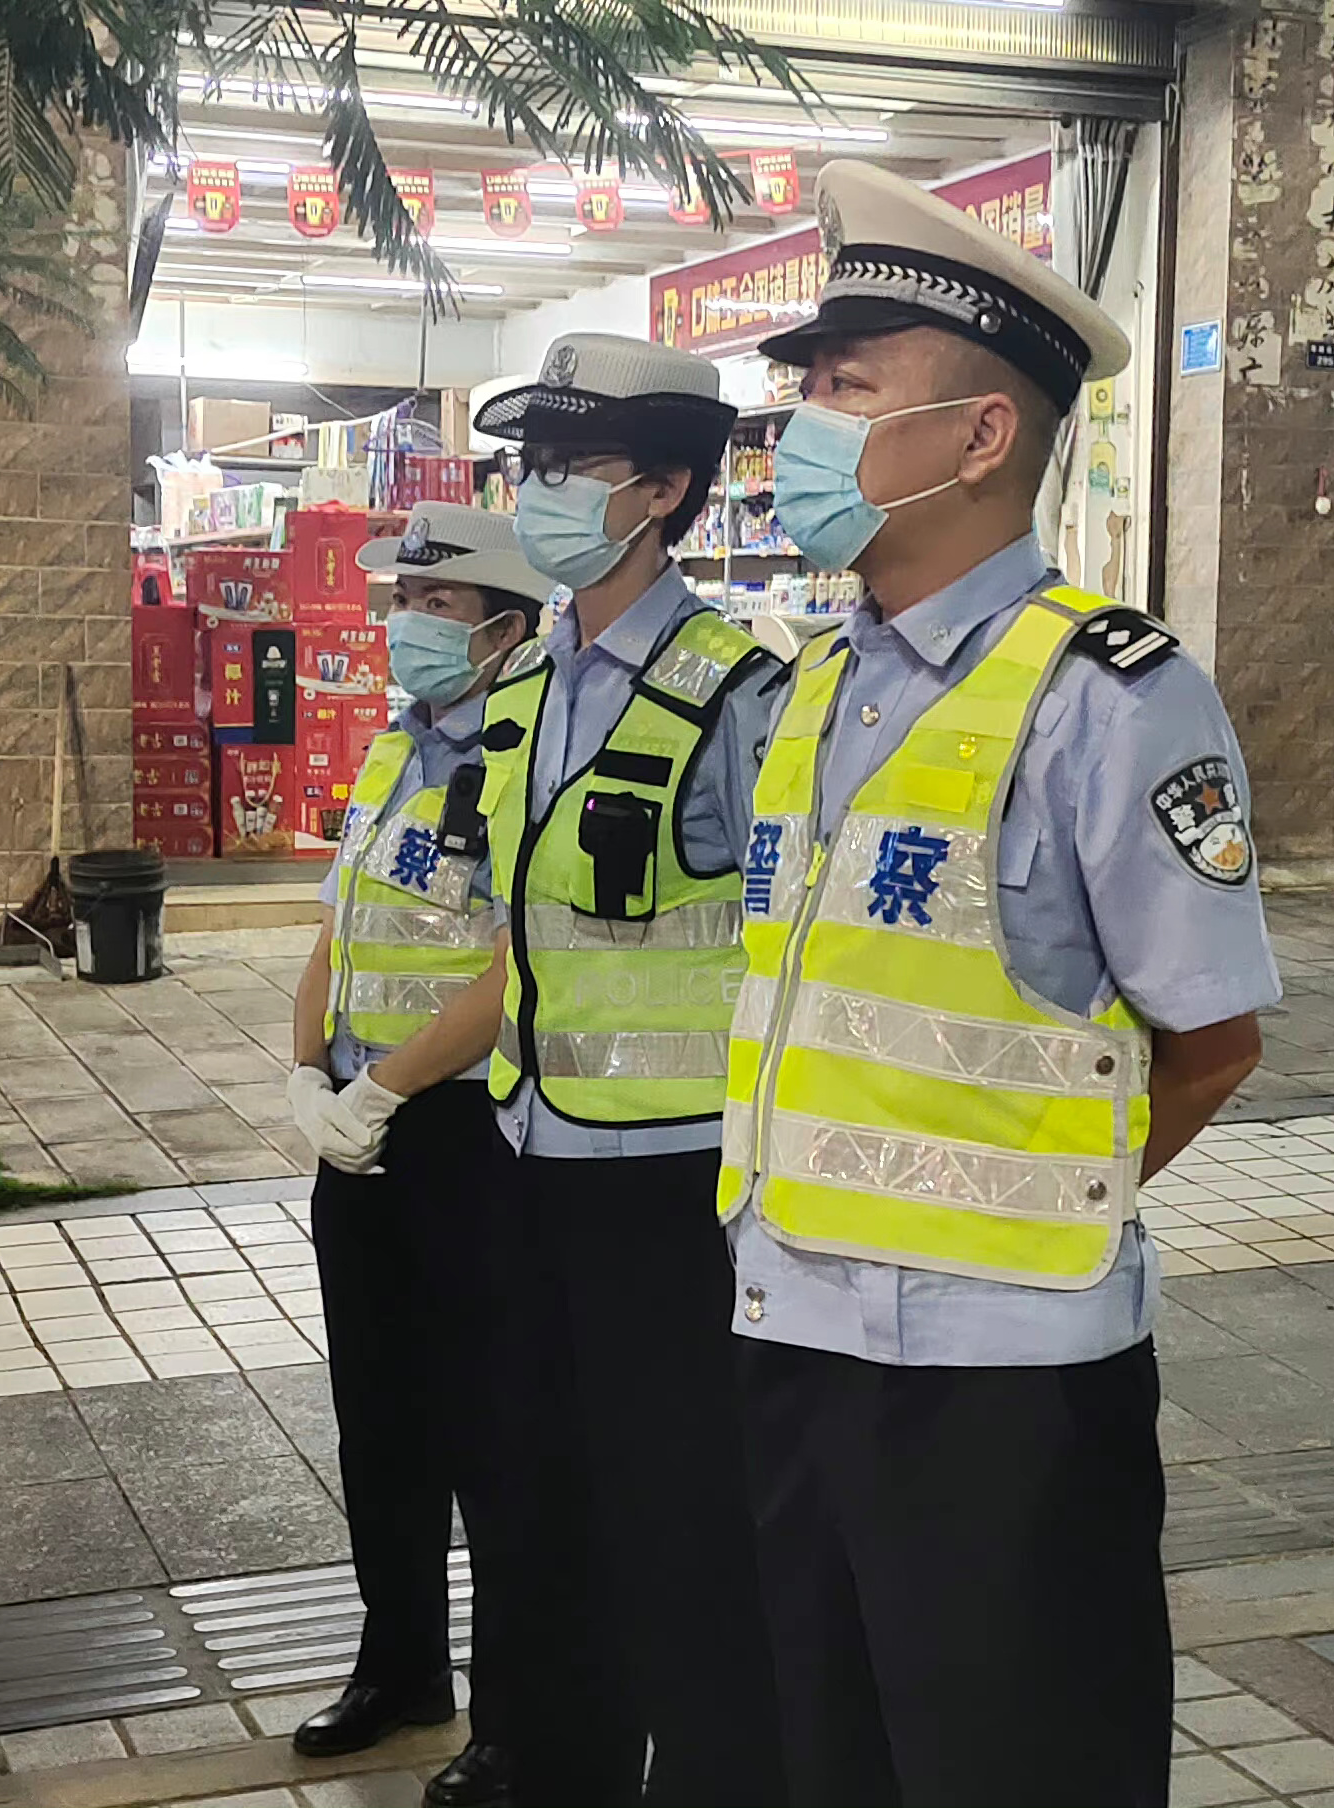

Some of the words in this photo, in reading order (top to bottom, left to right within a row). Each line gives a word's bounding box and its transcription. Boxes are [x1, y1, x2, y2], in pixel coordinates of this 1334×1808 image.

[744, 820, 783, 915] 警
[867, 825, 951, 927] 察
[575, 966, 747, 1008] POLICE
